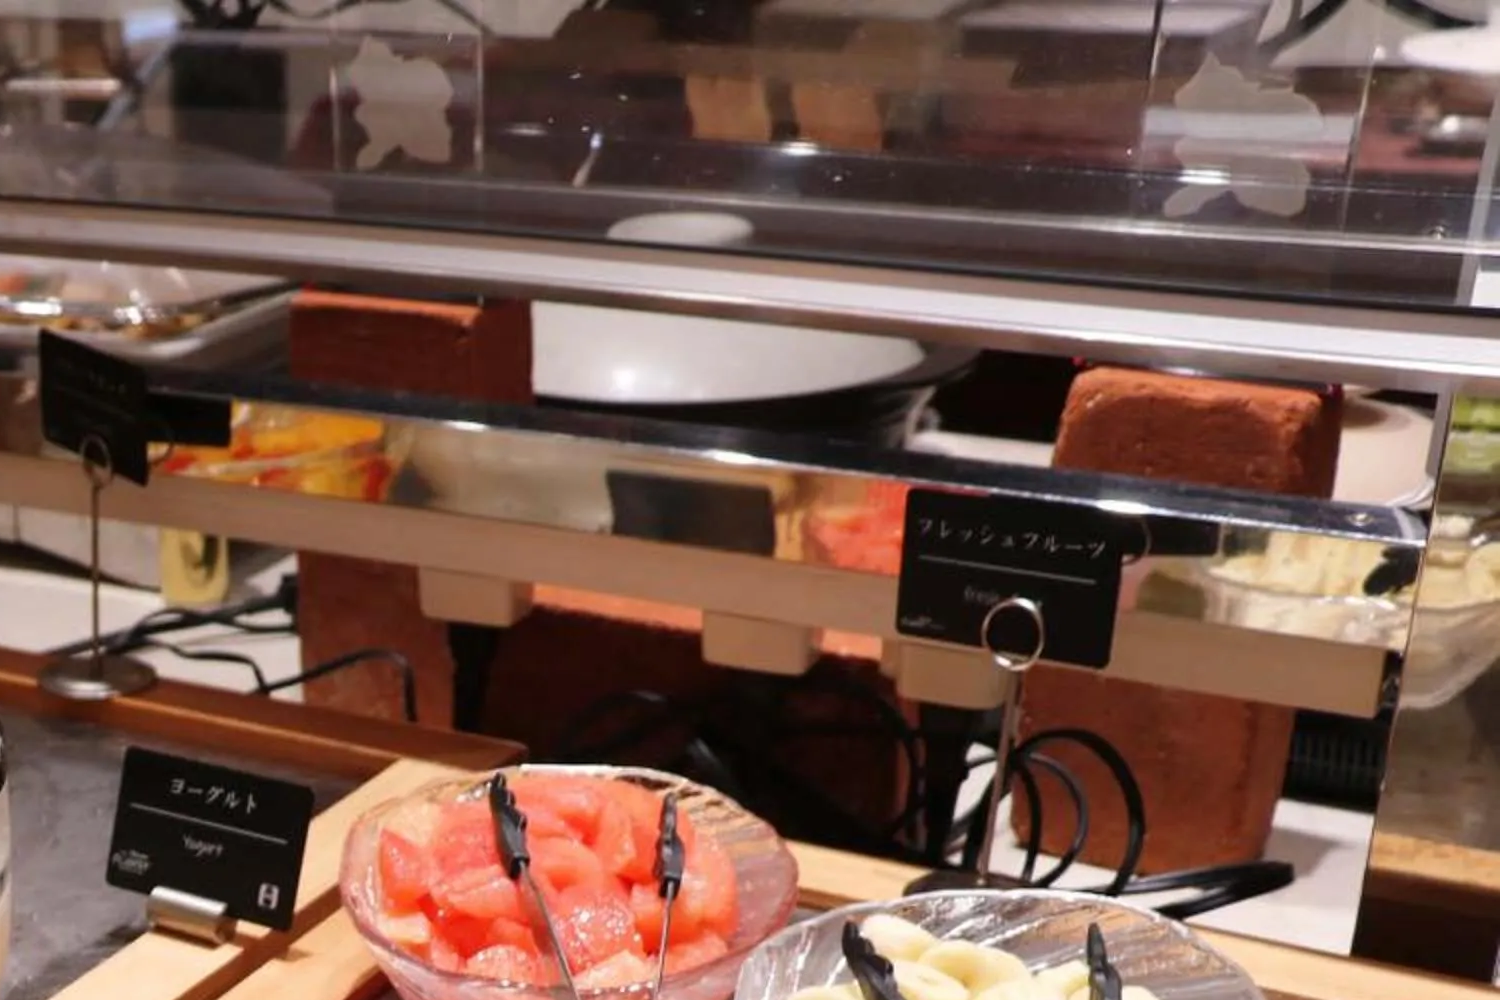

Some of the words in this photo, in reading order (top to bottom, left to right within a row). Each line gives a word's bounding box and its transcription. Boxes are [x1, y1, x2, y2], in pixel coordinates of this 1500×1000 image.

[170, 777, 257, 814] ヨーグルト
